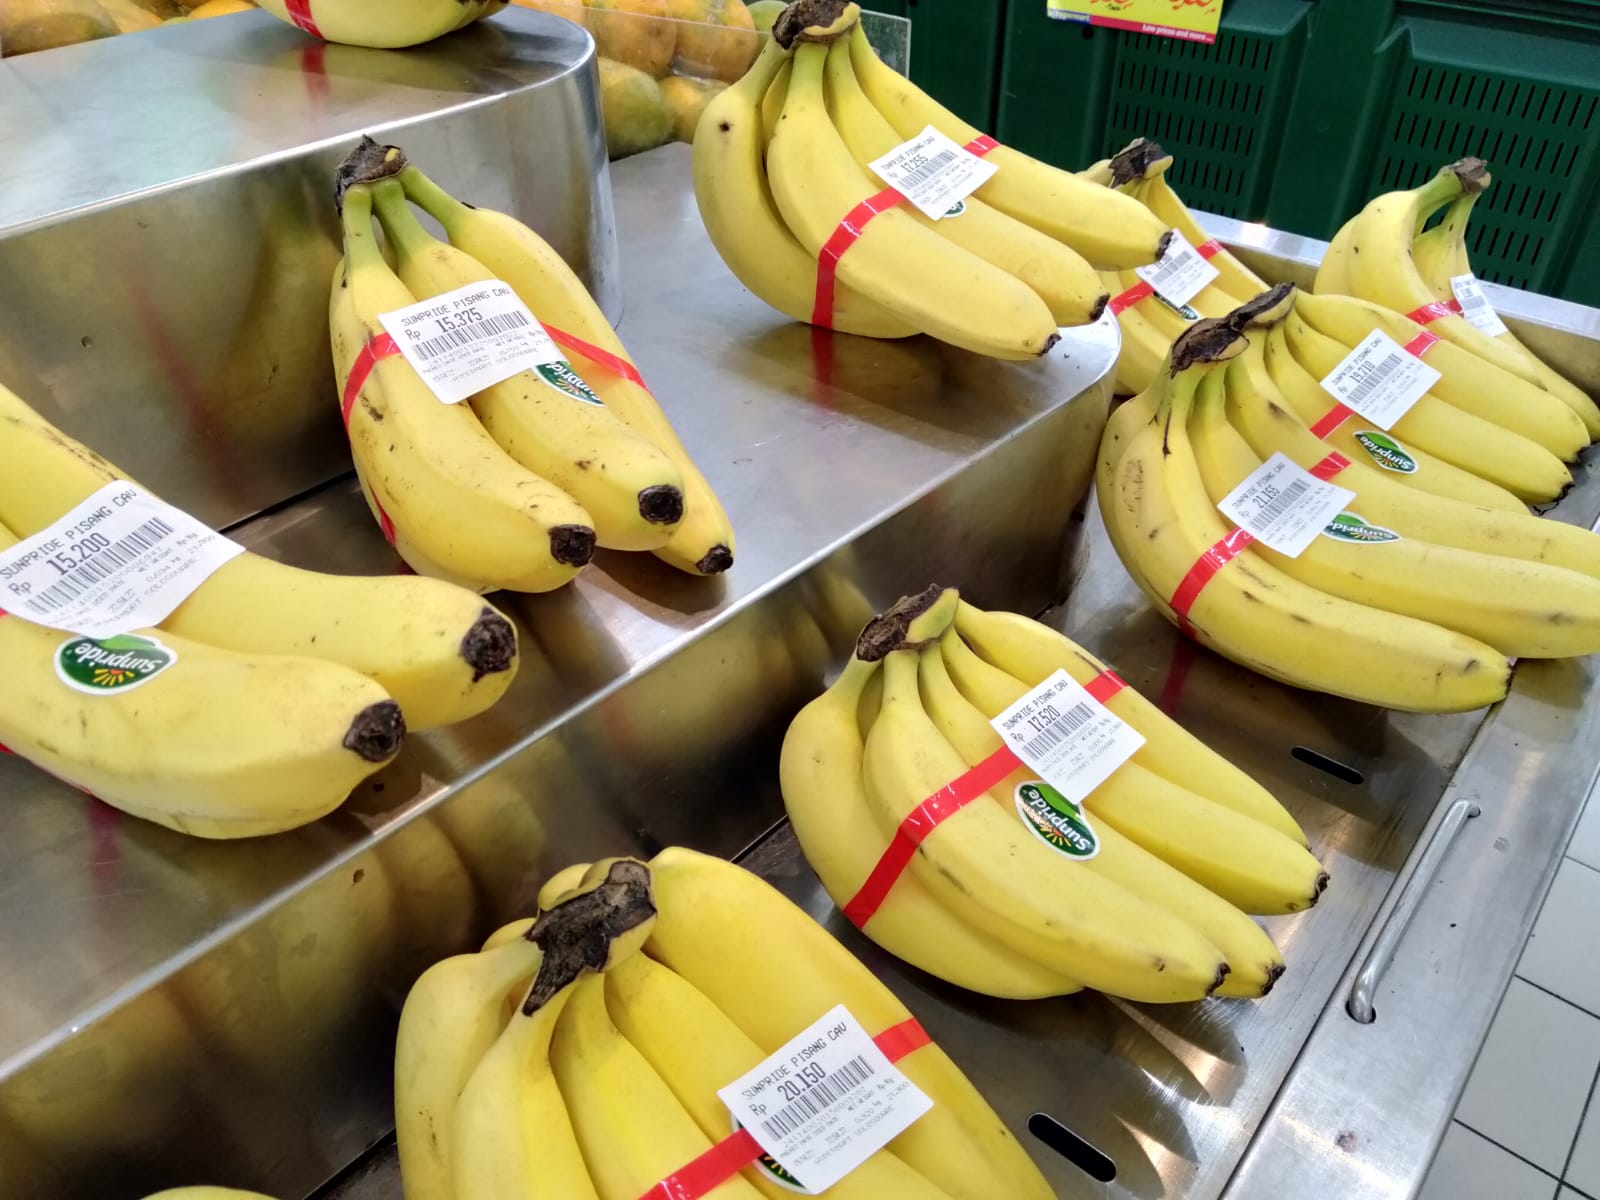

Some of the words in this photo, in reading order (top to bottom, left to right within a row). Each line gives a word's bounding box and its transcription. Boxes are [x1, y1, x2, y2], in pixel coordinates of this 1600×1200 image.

[401, 305, 450, 326] SUNPRIDE
[454, 291, 489, 309] PISANG
[492, 289, 510, 302] CAV
[406, 329, 420, 341] Rp
[435, 308, 483, 333] 15.375
[1350, 361, 1376, 383] 19.710
[1360, 436, 1412, 469] Sunpride
[1252, 484, 1280, 508] 21.155
[0, 538, 64, 579] SUNPRIDE
[67, 506, 113, 540] PISANG
[112, 488, 137, 507] CAV
[8, 580, 32, 597] Rp
[46, 532, 110, 576] 15.200
[75, 642, 163, 673] Sunpride
[1002, 704, 1033, 730] SUNPRIDE
[1034, 689, 1056, 707] PISANG
[1054, 679, 1068, 691] CAV
[1010, 732, 1024, 743] Rp
[1028, 705, 1061, 732] 17.520
[1028, 789, 1091, 850] Sunpride
[741, 1064, 791, 1100] SUNPRIDE
[792, 1038, 827, 1068] PISANG
[827, 1021, 847, 1042] CAV
[749, 1103, 767, 1117] Rp
[777, 1061, 826, 1101] 20.150
